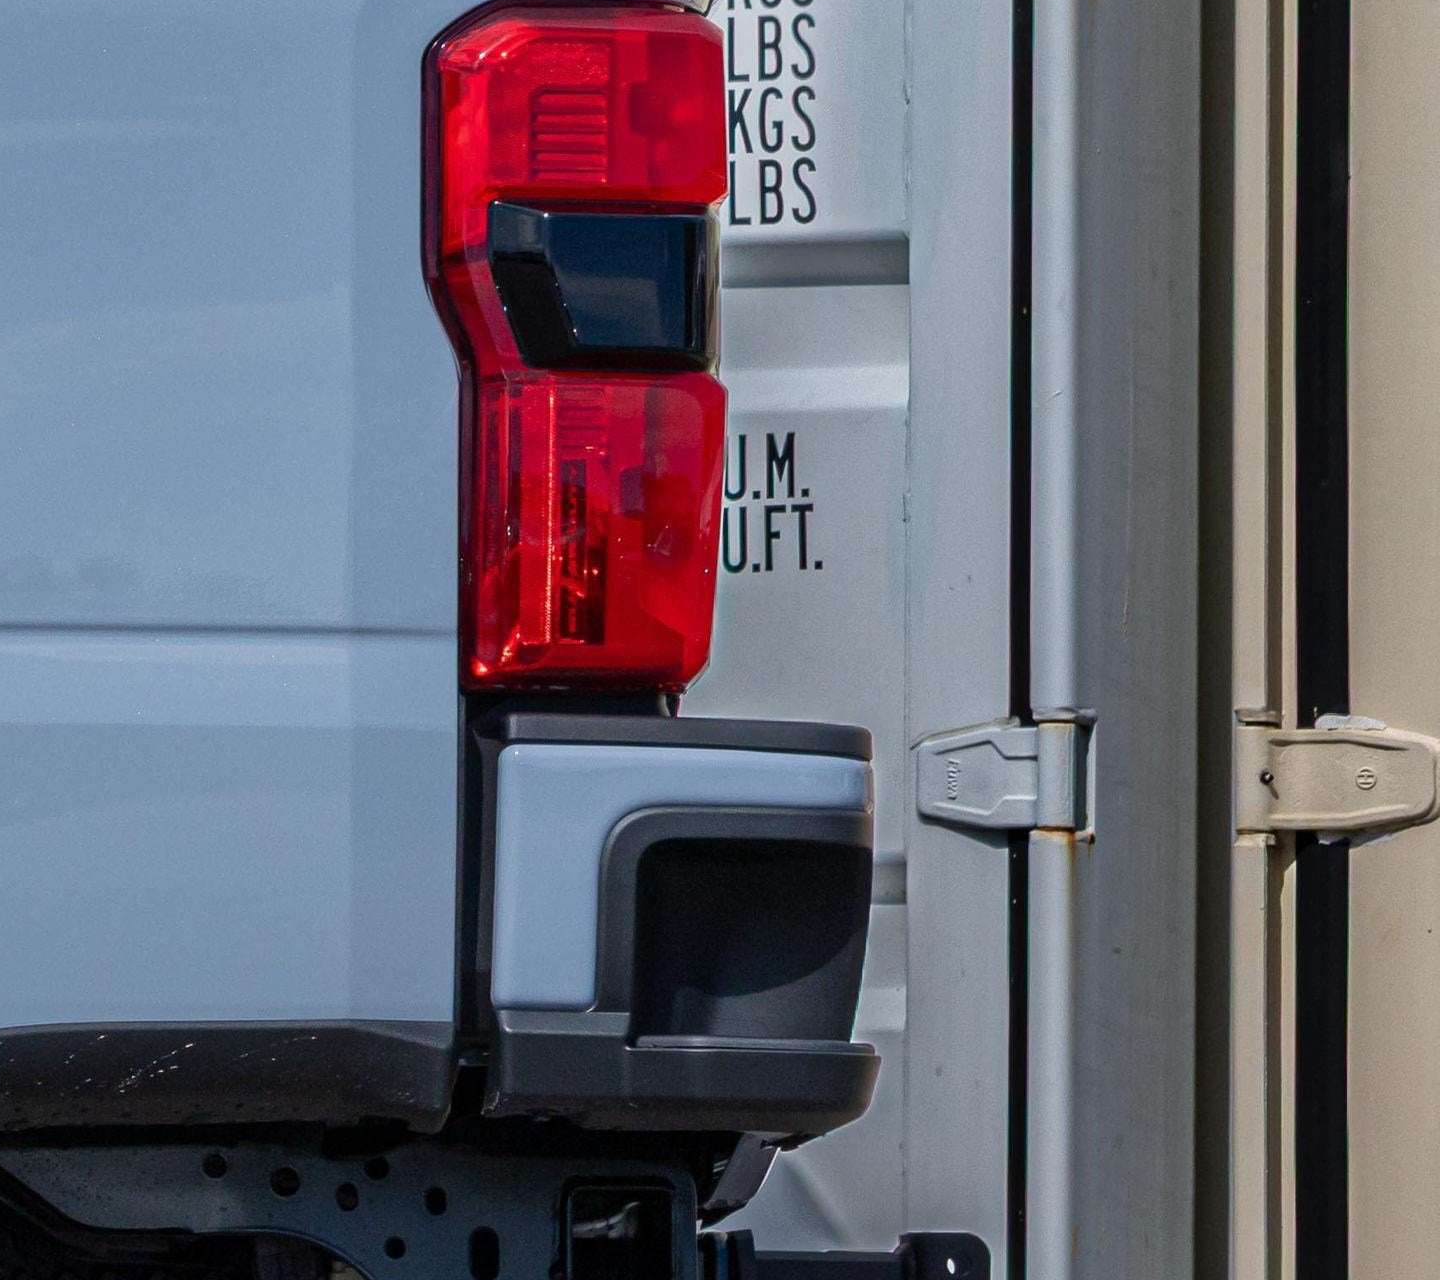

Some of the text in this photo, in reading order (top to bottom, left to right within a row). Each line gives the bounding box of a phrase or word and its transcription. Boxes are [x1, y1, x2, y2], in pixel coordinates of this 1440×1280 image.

[727, 13, 816, 82] LBS
[728, 86, 816, 154] KGS
[729, 157, 817, 225] LBS
[724, 432, 809, 501] U.M.
[722, 503, 823, 574] U.FT.
